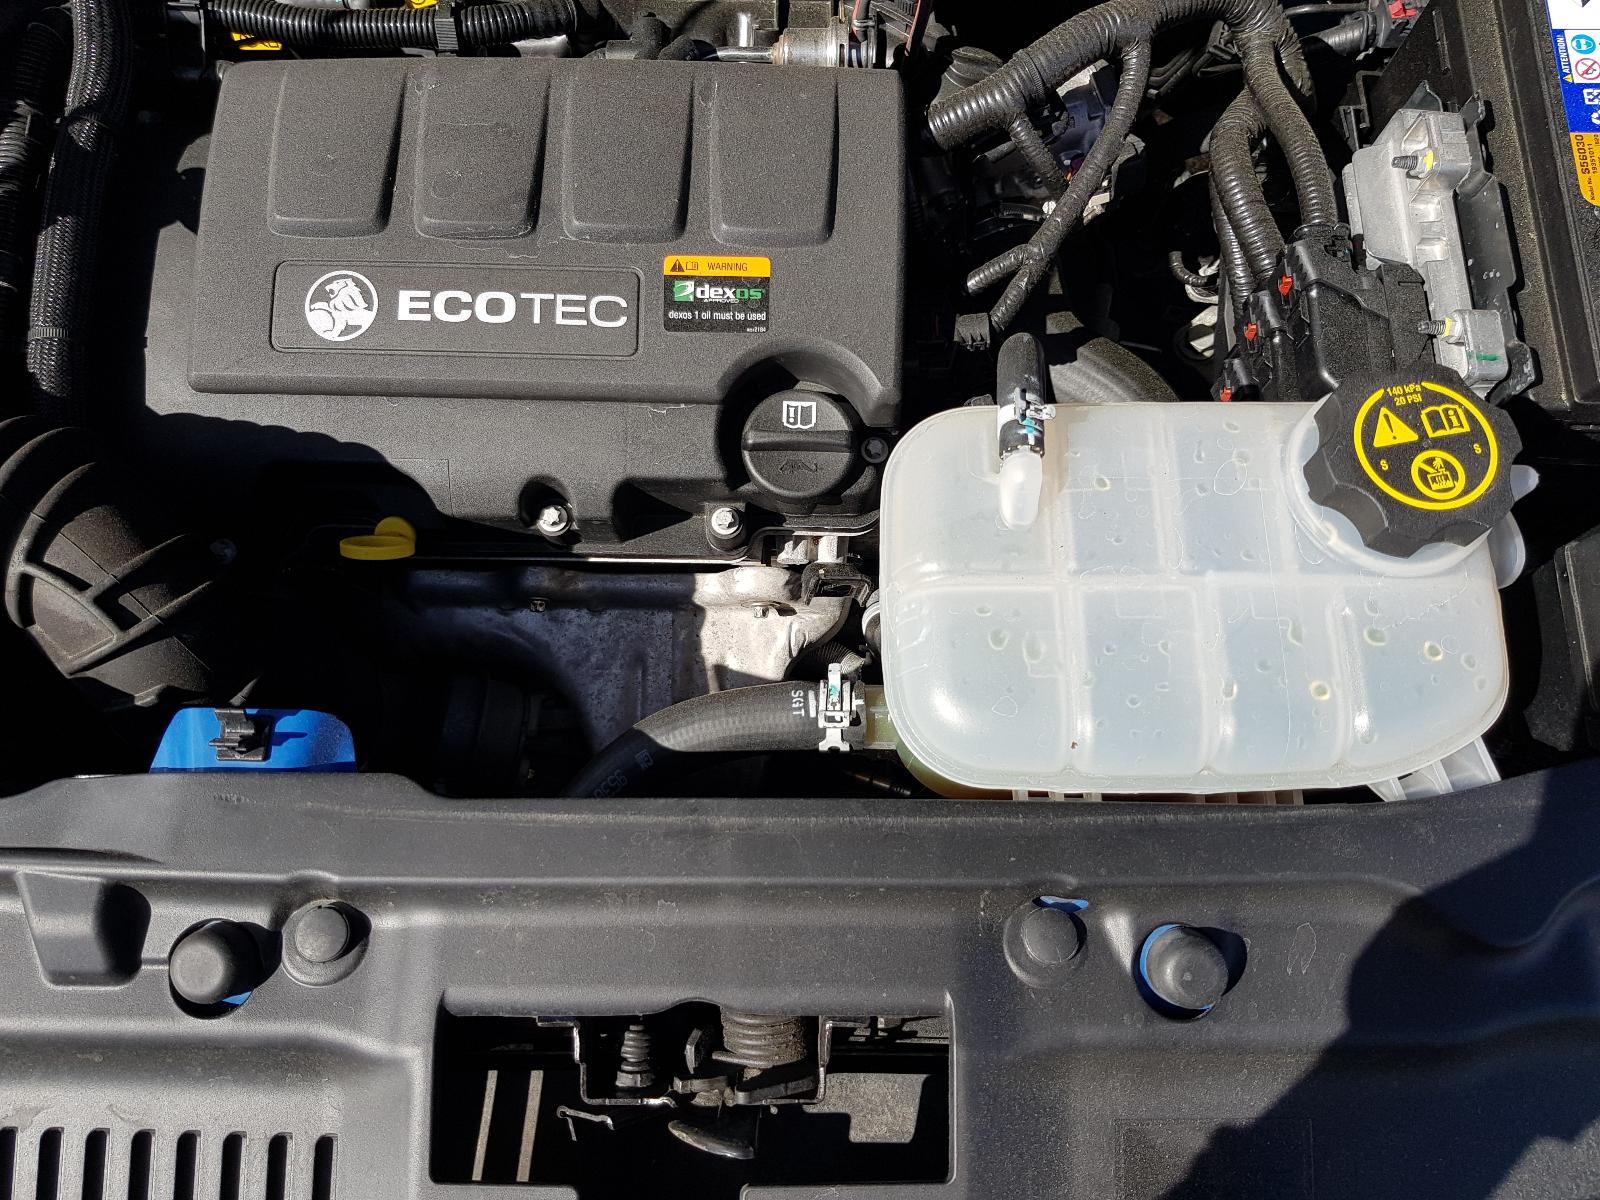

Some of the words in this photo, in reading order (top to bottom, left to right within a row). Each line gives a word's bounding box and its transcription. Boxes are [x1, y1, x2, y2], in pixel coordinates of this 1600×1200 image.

[707, 261, 748, 271] WARNING
[696, 284, 763, 299] dexos
[397, 289, 628, 328] ECOTEC
[668, 310, 692, 319] dexos
[695, 311, 699, 319] 1
[701, 311, 711, 320] oil
[713, 312, 733, 320] must
[735, 311, 745, 320] be
[747, 311, 766, 320] used
[1386, 384, 1403, 397] 140
[1405, 383, 1422, 394] kPa
[1394, 396, 1406, 406] 20
[1407, 393, 1422, 404] PSI
